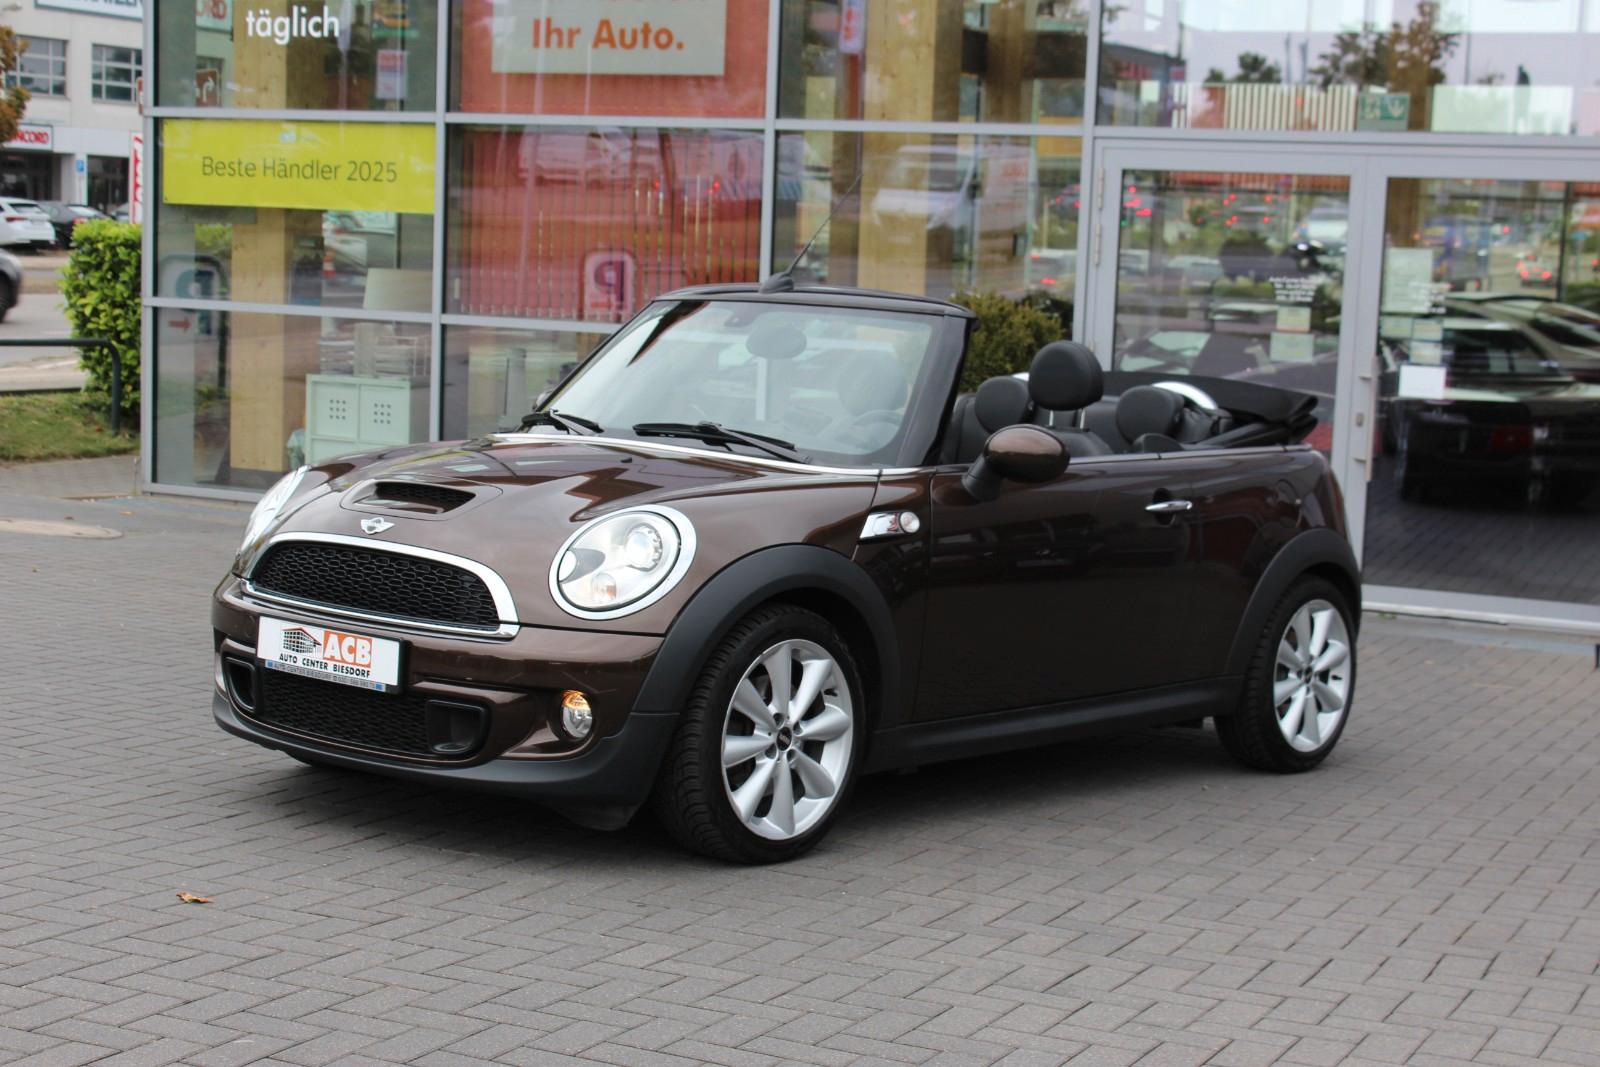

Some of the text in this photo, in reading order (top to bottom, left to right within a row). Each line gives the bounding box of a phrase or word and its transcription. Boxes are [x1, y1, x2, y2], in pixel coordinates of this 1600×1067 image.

[246, 5, 340, 45] täglich
[532, 17, 685, 50] Ihr Auto.
[201, 156, 398, 183] Beste Händler 2025
[279, 653, 371, 679] AUTO CENTER BIESDORF
[324, 633, 372, 666] ACB
